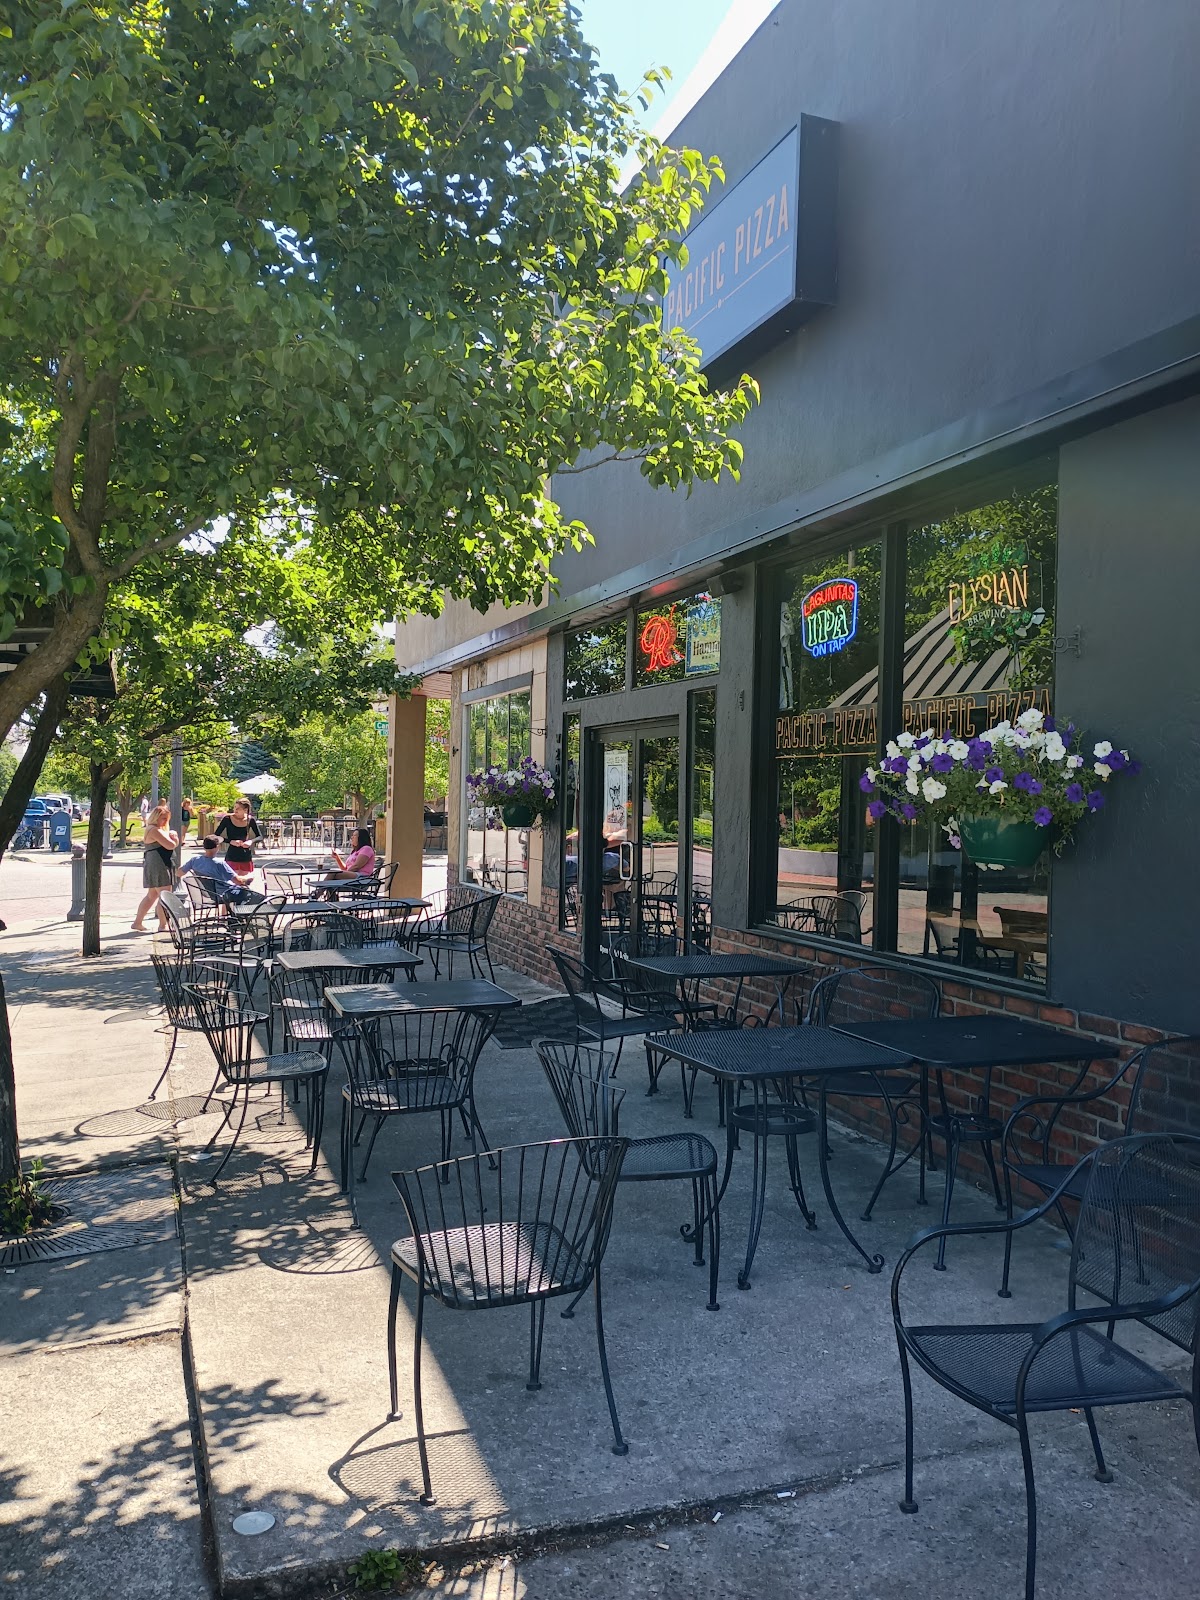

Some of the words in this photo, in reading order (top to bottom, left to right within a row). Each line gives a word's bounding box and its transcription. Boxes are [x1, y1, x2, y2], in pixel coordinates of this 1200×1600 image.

[668, 241, 726, 331] PACIFIC
[734, 184, 789, 275] PIZZA
[803, 583, 855, 617] LAGUNITAS
[947, 565, 1029, 625] ELYSIAN
[807, 605, 849, 647] IPA
[967, 607, 1006, 627] BREWING
[812, 643, 827, 657] ON
[827, 638, 846, 653] TAP
[775, 713, 827, 750] PACIFIC
[833, 707, 877, 746] PIZZA
[902, 697, 976, 738] PACIFIC
